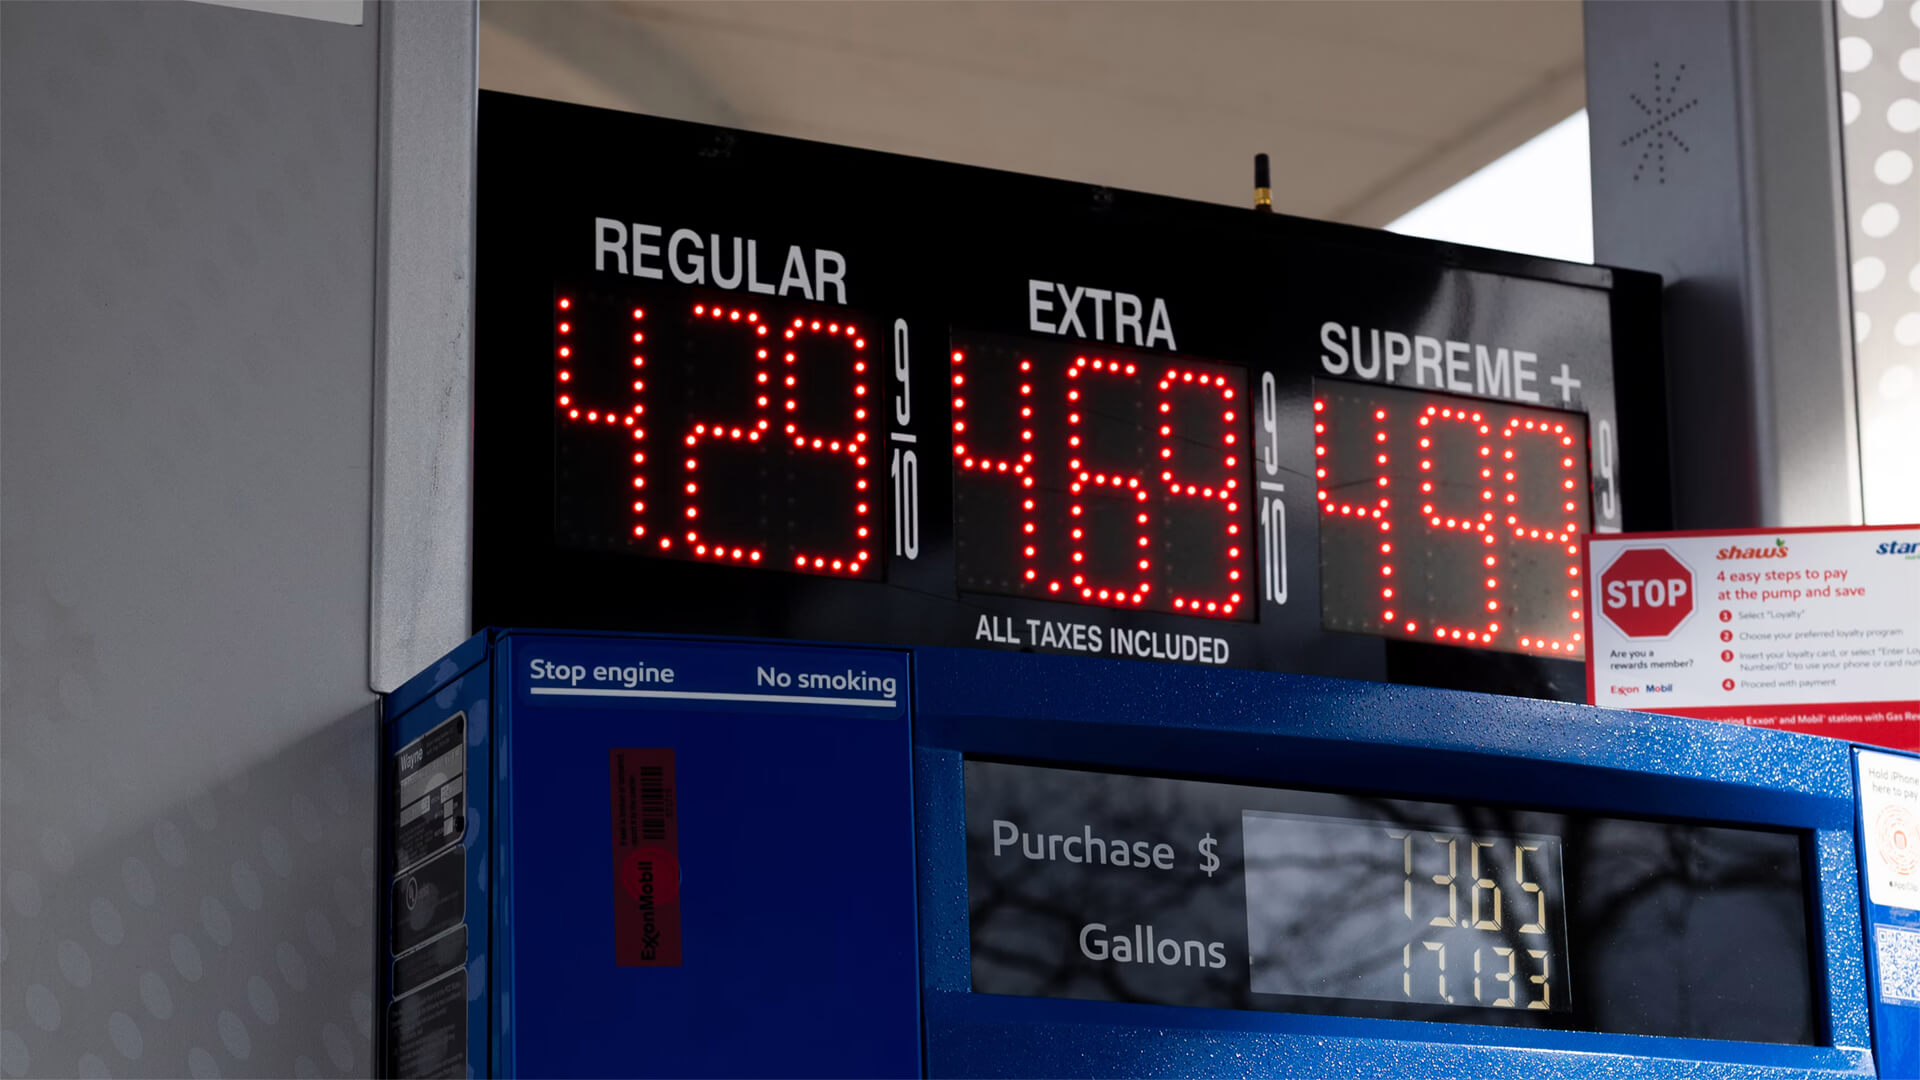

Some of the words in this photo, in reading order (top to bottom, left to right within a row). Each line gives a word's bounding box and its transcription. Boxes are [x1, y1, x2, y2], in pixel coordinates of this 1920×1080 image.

[595, 216, 848, 305] REGULAR
[1029, 279, 1177, 351] EXTRA
[894, 317, 911, 426] 9
[1320, 321, 1540, 402] SUPREME
[558, 297, 869, 573] 4.29
[1261, 370, 1279, 477] 9
[951, 351, 1241, 614] 4.69
[1598, 418, 1615, 520] 9
[890, 447, 919, 560] 10
[1312, 400, 1583, 653] 4.99
[1260, 496, 1288, 605] 10
[1876, 540, 1920, 554] star
[1607, 577, 1687, 608] STOP
[1716, 571, 1726, 582] 4
[1730, 572, 1761, 583] easy
[1765, 570, 1801, 583] steps
[1805, 569, 1819, 580] to
[1824, 569, 1848, 582] pay
[1718, 590, 1731, 601] at
[1735, 588, 1757, 600] the
[1762, 588, 1801, 602] pump
[1805, 586, 1830, 598] and
[1835, 586, 1866, 596] save
[976, 613, 1020, 644] ALL
[1026, 618, 1102, 652] TAXES
[1110, 628, 1230, 664] INCLUDED
[1738, 610, 1765, 620] Select
[1739, 631, 1772, 641] Choose
[1774, 631, 1793, 642] your
[1795, 629, 1834, 640] preferred
[1836, 628, 1864, 639] loyalty
[1866, 628, 1903, 638] program
[530, 658, 586, 687] Stop
[593, 661, 675, 689] engine
[1610, 649, 1627, 658] Are
[1629, 649, 1646, 659] you
[1610, 660, 1648, 670] rewards
[1650, 658, 1694, 669] member?
[1740, 651, 1764, 660] Insert
[1766, 651, 1784, 661] your
[1786, 649, 1814, 660] loyalty
[756, 666, 791, 687] No
[797, 669, 897, 698] smoking
[1610, 684, 1640, 696] Exxon
[1646, 683, 1673, 693] Mobil
[1740, 679, 1776, 689] Proceed
[1778, 678, 1797, 688] with
[1799, 678, 1837, 689] payment
[1779, 715, 1796, 725] and
[399, 746, 424, 772] Wayne
[991, 819, 1175, 870] Purchase
[1198, 832, 1221, 878] $
[1384, 828, 1546, 935] 73.65
[638, 860, 662, 962] ExxonMobil
[1078, 922, 1227, 969] Gallons
[1403, 941, 1551, 1010] 17.133
